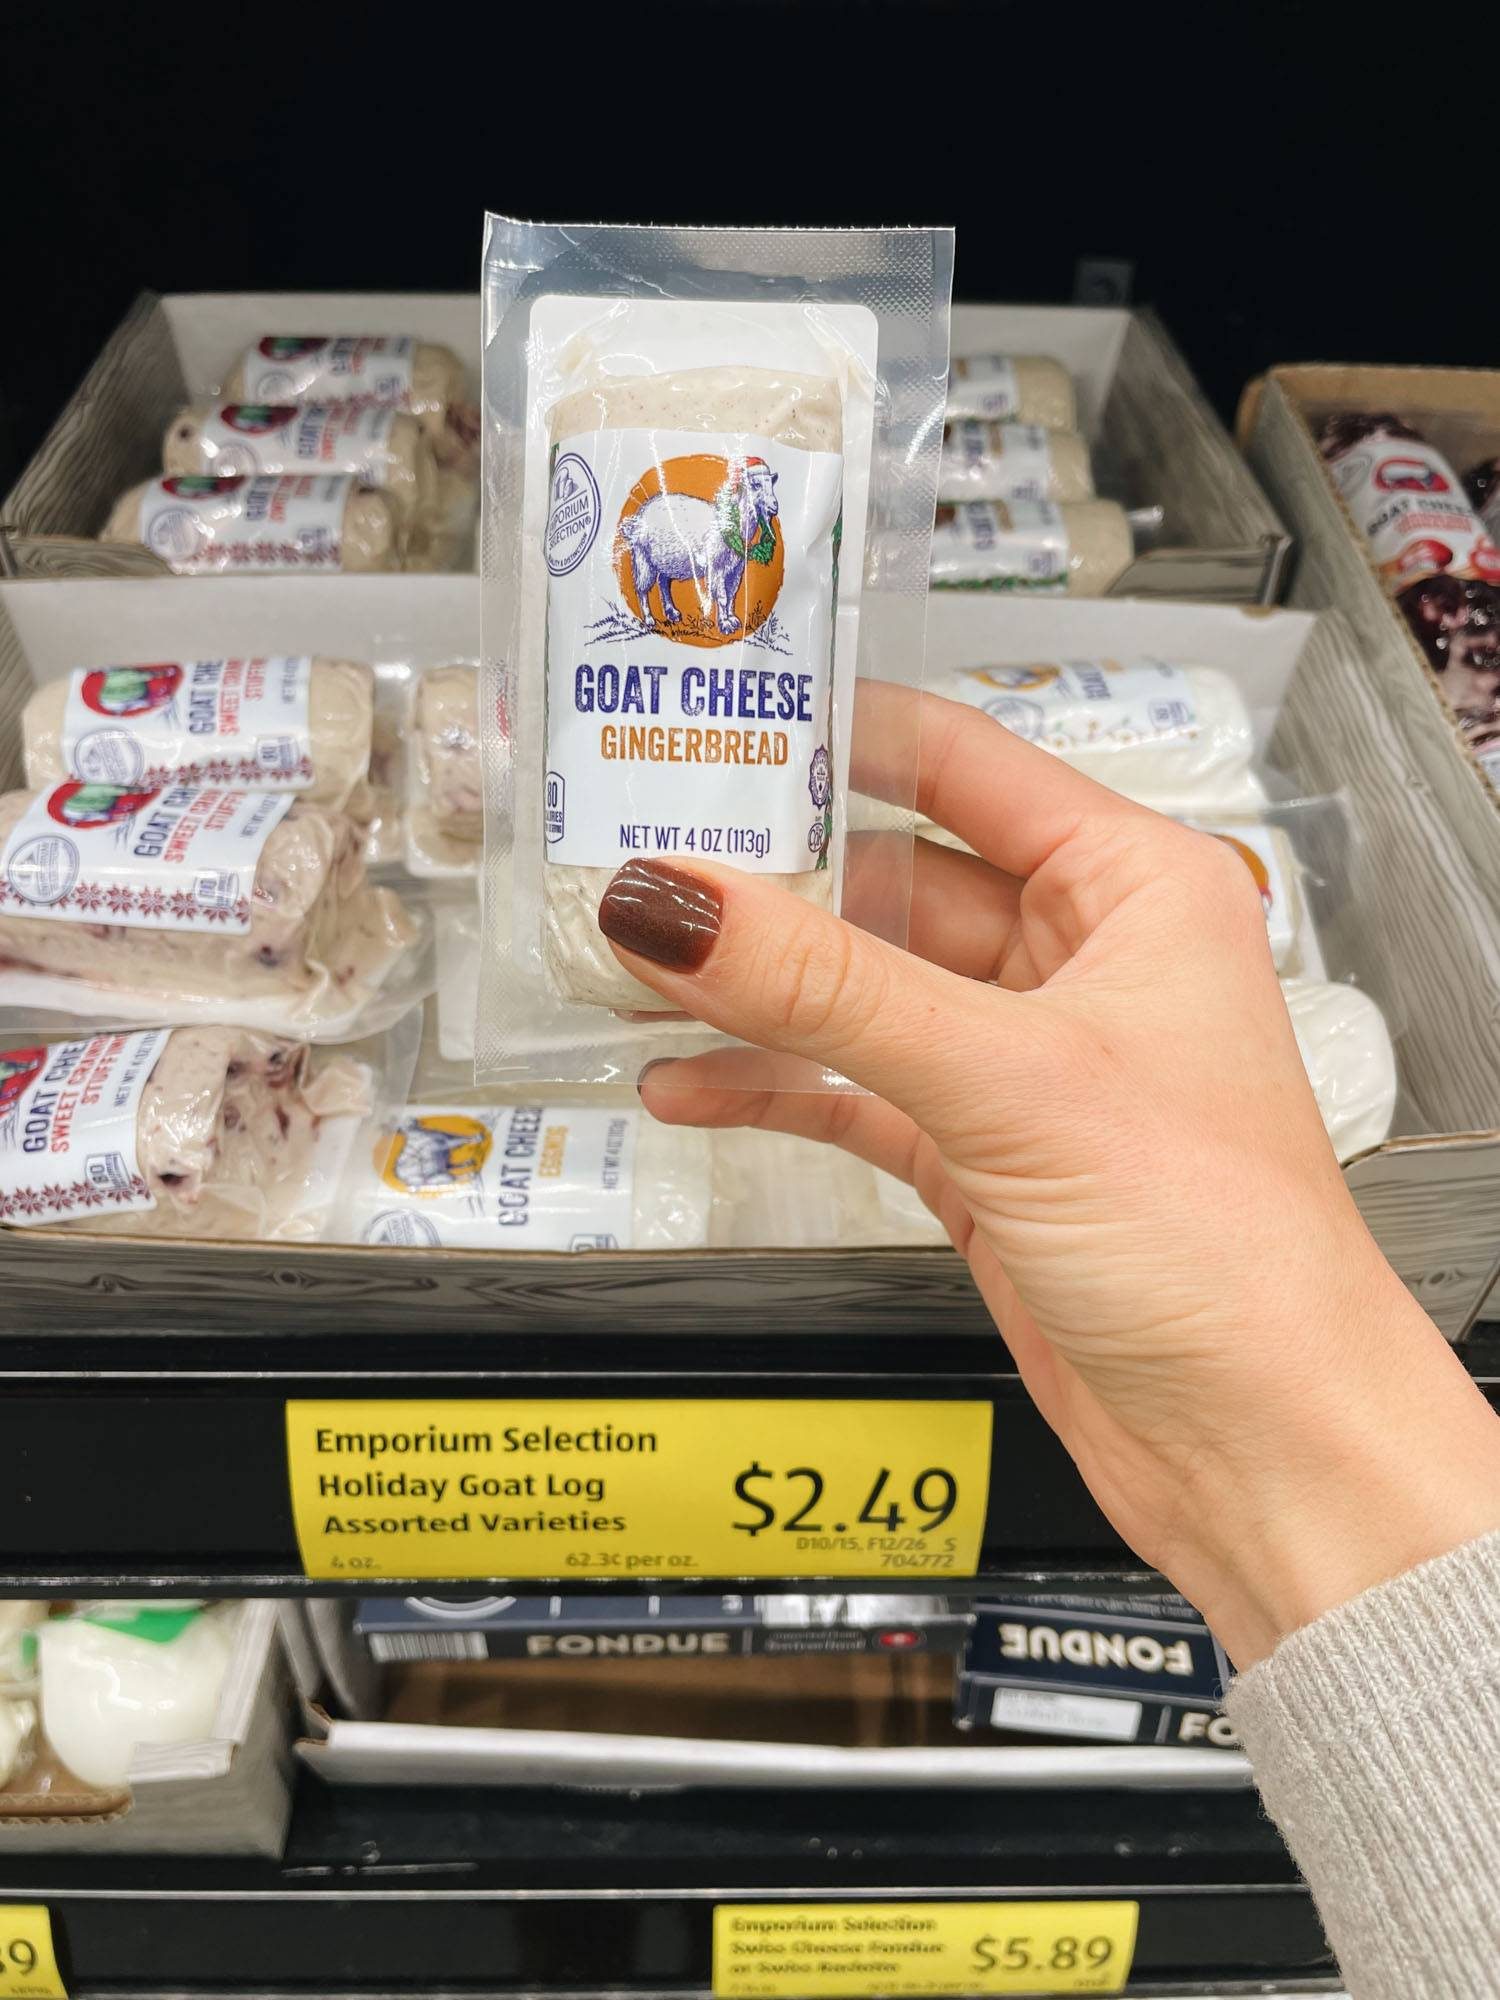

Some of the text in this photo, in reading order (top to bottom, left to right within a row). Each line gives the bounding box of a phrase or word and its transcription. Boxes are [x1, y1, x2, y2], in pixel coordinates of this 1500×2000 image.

[189, 689, 218, 734] GOAT
[575, 664, 813, 722] GOAT CHEESE
[601, 725, 789, 766] GINGERBREAD
[548, 781, 557, 808] 80
[134, 812, 181, 857] GOAT
[620, 824, 771, 858] NET WT 4 OZ (113g)
[23, 1090, 60, 1153] GOAT
[51, 1091, 79, 1153] SWEET
[498, 1163, 532, 1226] GOAT
[316, 1424, 658, 1459] Emporium Selection
[318, 1471, 606, 1503] Holiday Goat Log
[732, 1461, 958, 1537] $2.49
[323, 1511, 627, 1535] Assorted Varieties
[625, 1554, 663, 1571] per
[667, 1555, 700, 1568] oz.
[880, 1554, 954, 1568] 704772
[867, 1537, 928, 1551] F12/26
[526, 1633, 731, 1656] FONDUE
[998, 1623, 1195, 1677] FONDUE
[973, 1934, 1114, 1974] $5.89
